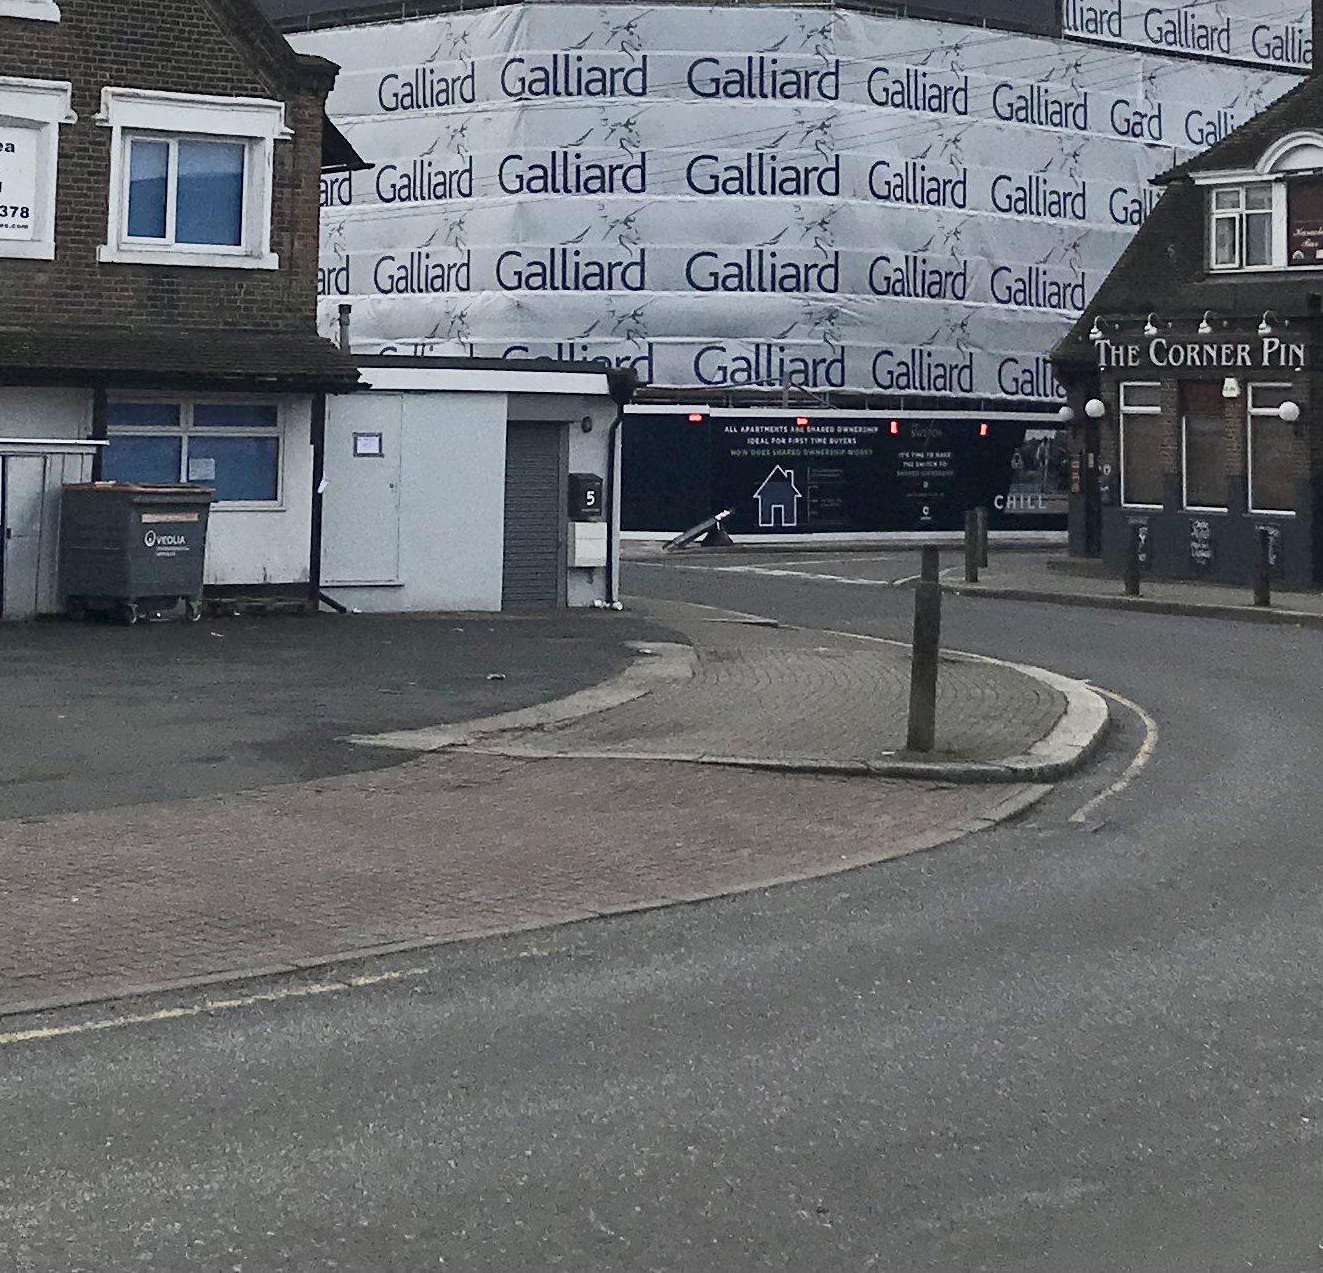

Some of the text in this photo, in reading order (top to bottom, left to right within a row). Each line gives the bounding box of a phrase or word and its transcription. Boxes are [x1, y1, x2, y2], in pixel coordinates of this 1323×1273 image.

[1144, 8, 1231, 55] Galliard
[378, 60, 476, 112] Galliard
[500, 53, 648, 98] Galliard
[686, 56, 840, 101] Galliard
[867, 66, 969, 116] Galliard
[992, 83, 1088, 131] Galliard
[375, 155, 473, 204] Galliard
[498, 150, 646, 194] Galliard
[685, 152, 840, 196] Galliard
[868, 160, 967, 209] Galliard
[991, 175, 1086, 220] Galliard
[373, 249, 471, 295] Galliard
[496, 247, 646, 291] Galliard
[685, 248, 839, 293] Galliard
[868, 255, 967, 300] Galliard
[990, 266, 1085, 312] Galliard
[694, 343, 845, 388] Galliard
[872, 348, 974, 394] Galliard
[1094, 337, 1306, 369] THE CORNER PIN
[587, 490, 596, 506] 5
[994, 495, 1046, 510] CHILL
